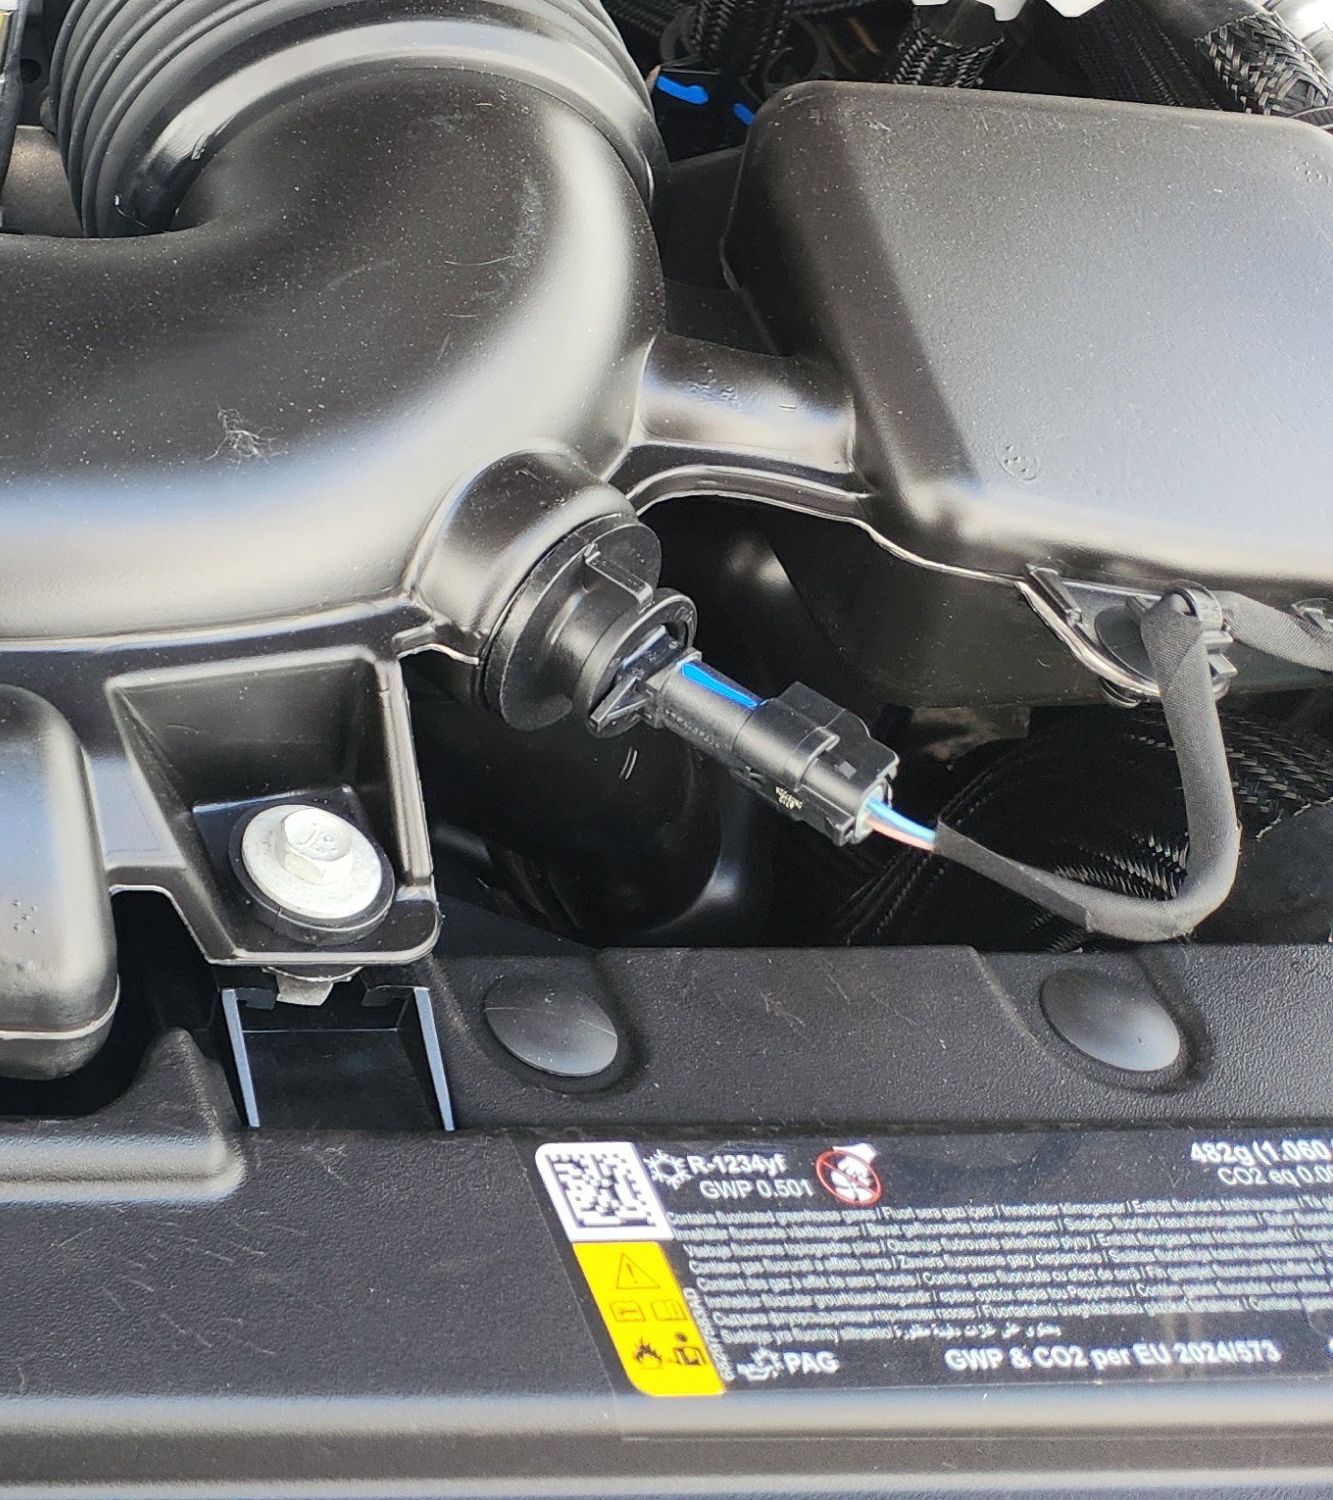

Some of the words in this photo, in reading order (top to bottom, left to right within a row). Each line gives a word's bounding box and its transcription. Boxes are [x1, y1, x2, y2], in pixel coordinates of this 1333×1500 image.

[686, 1154, 786, 1180] R-1234yf
[1217, 1167, 1268, 1186] CO2
[1268, 1169, 1301, 1188] eq
[699, 1180, 754, 1200] GWP
[756, 1179, 815, 1199] 0.501
[783, 1351, 840, 1375] PAG
[944, 1347, 1003, 1370] GWP
[1010, 1346, 1032, 1369] &
[1033, 1344, 1088, 1369] CO2
[1091, 1346, 1132, 1370] per
[1133, 1343, 1170, 1366] EU
[1173, 1340, 1281, 1364] 2024/573
